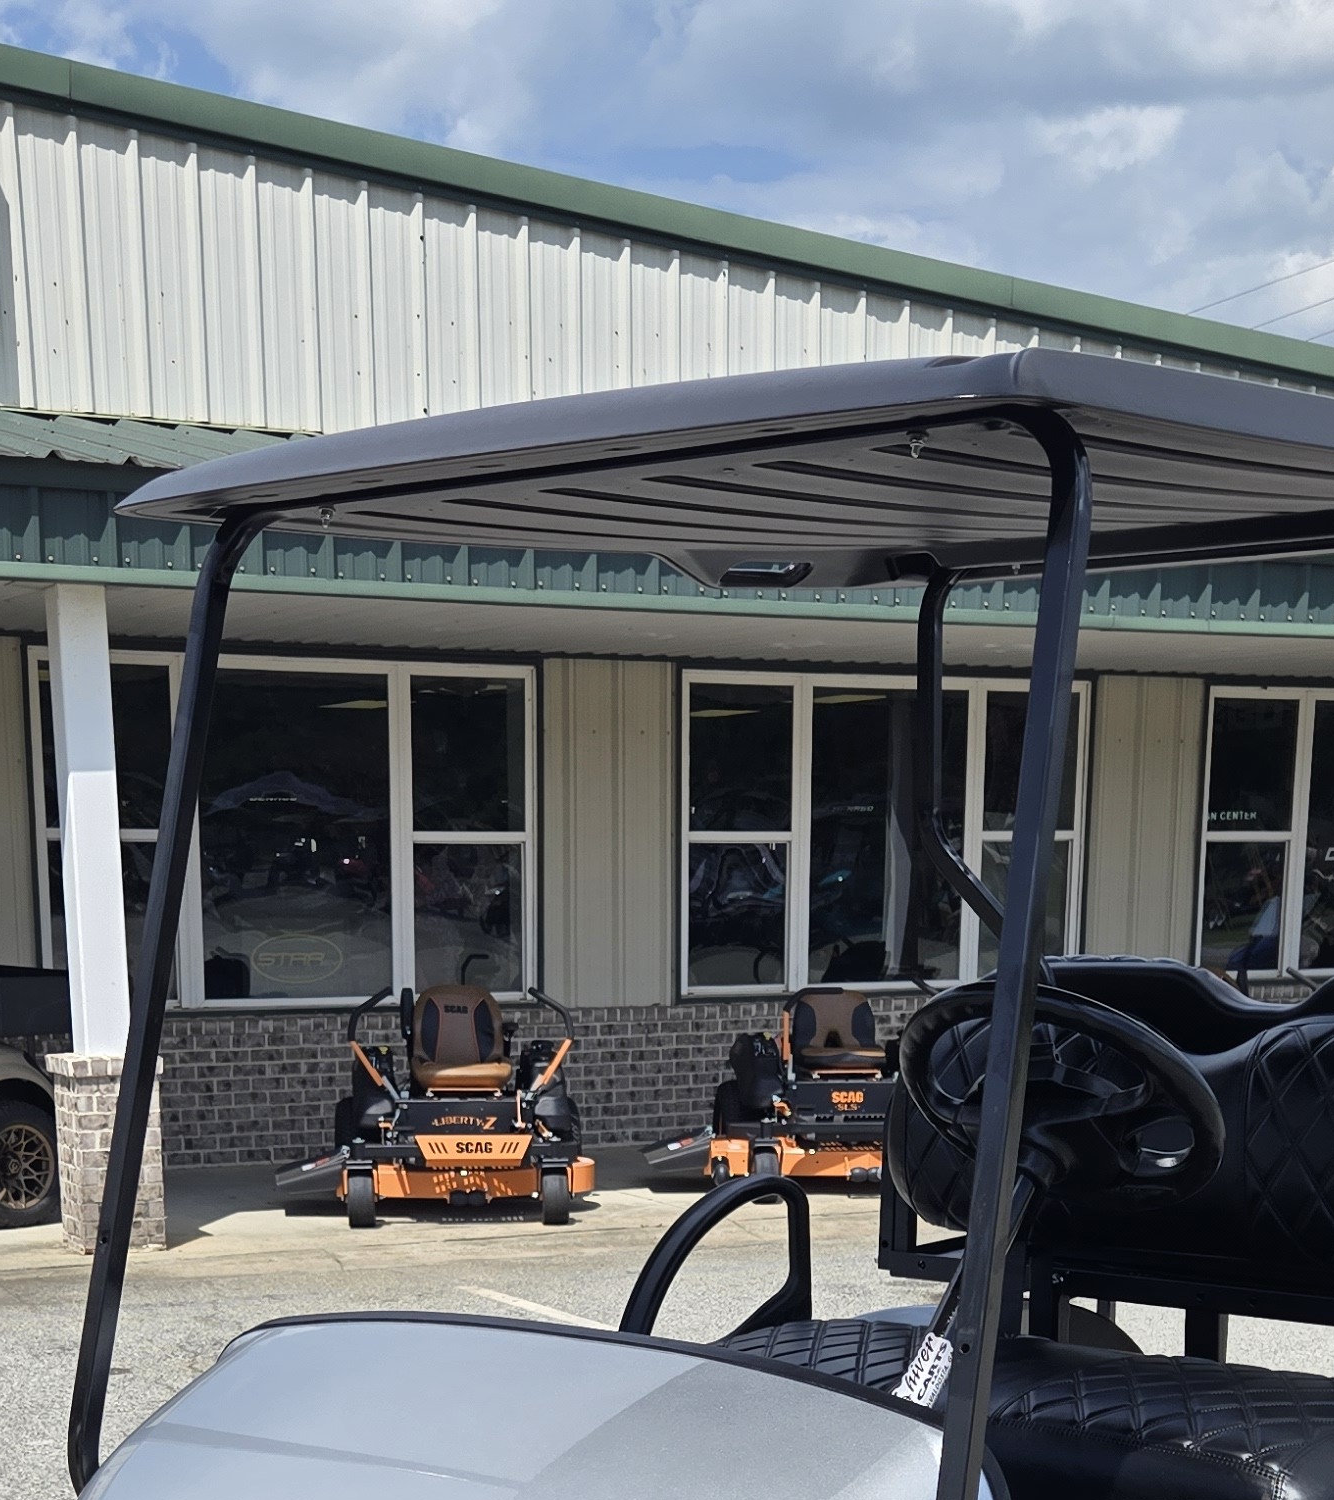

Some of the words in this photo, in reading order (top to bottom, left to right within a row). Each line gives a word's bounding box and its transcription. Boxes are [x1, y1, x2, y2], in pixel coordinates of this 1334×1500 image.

[1219, 811, 1257, 820] CENTER
[832, 1091, 864, 1103] SCAG
[456, 1142, 493, 1154] SCAG
[917, 1342, 947, 1400] CARTS
